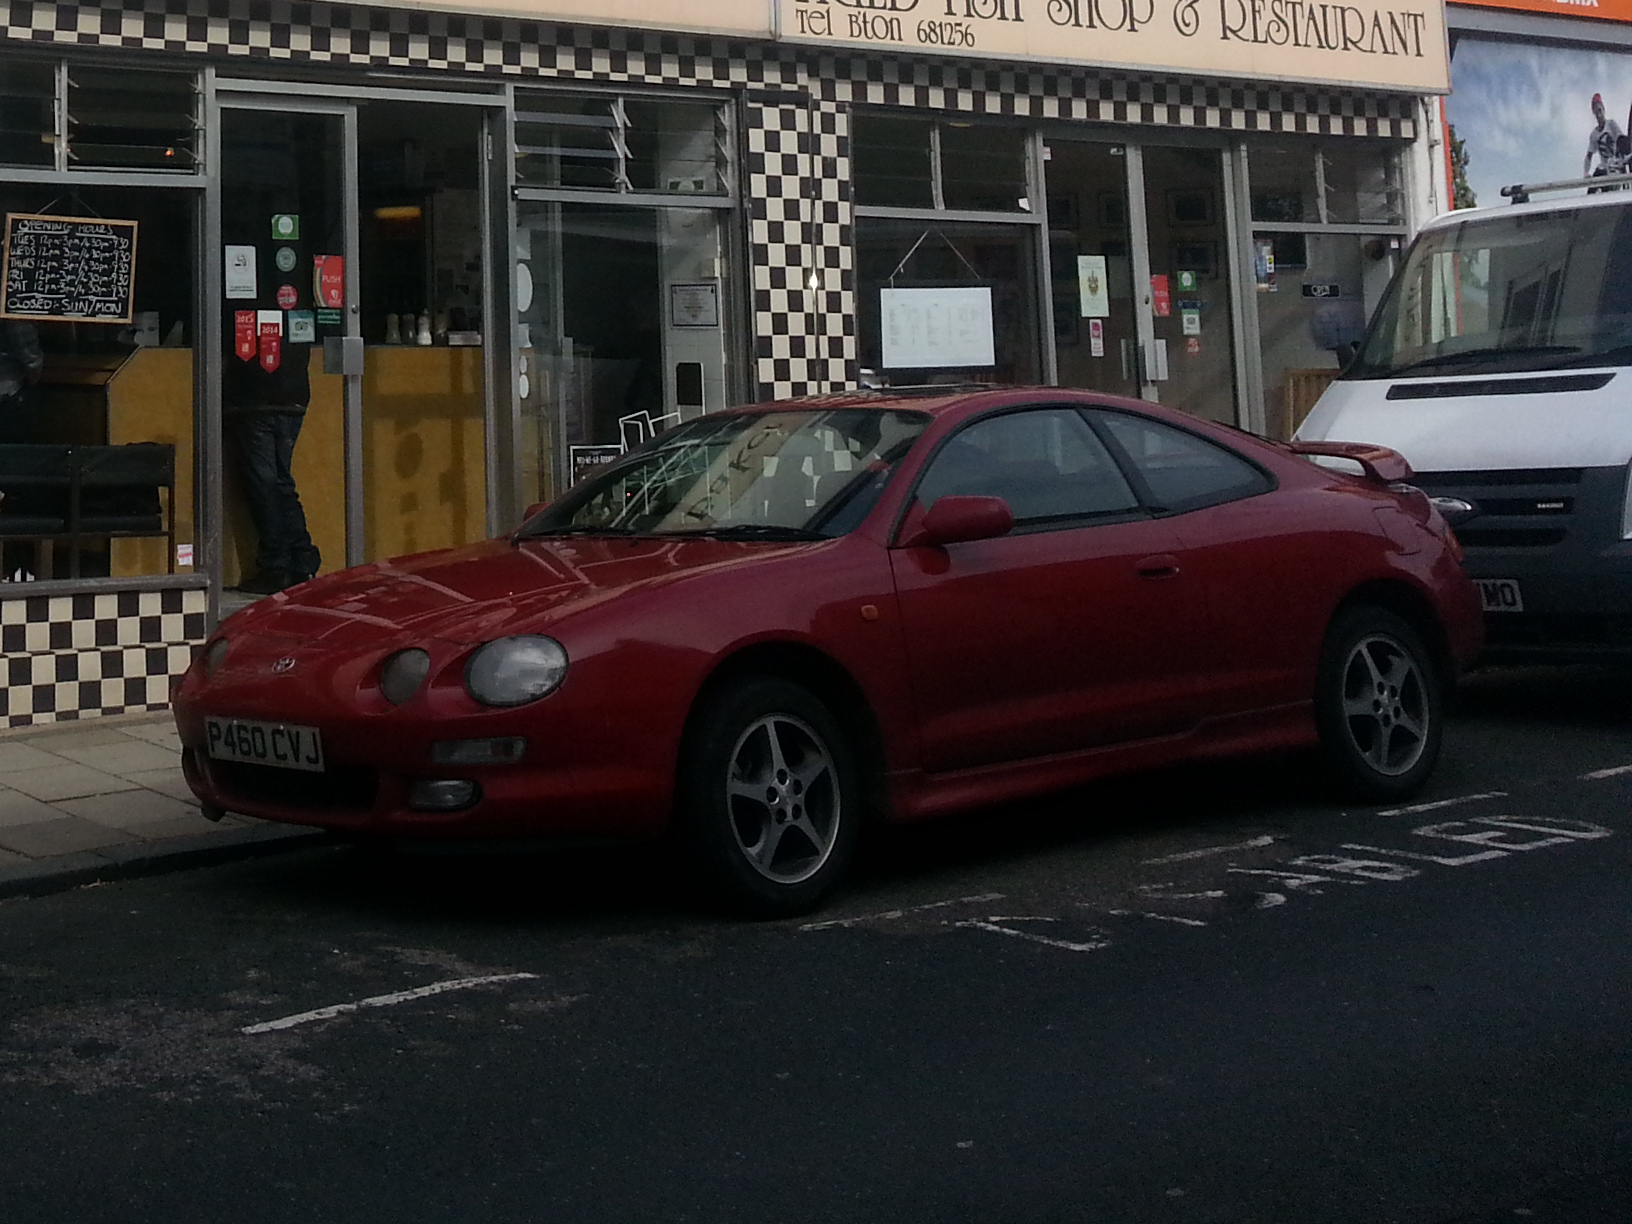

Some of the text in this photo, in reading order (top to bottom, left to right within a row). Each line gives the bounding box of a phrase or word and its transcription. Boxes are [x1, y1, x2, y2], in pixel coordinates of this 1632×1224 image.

[796, 8, 833, 36] Tel
[917, 19, 975, 47] 681256
[18, 220, 113, 234] OPENING HOURS
[11, 233, 35, 245] TUES
[10, 245, 36, 256] WEDS
[1476, 583, 1516, 607] MO
[208, 721, 319, 764] P460 CVJ
